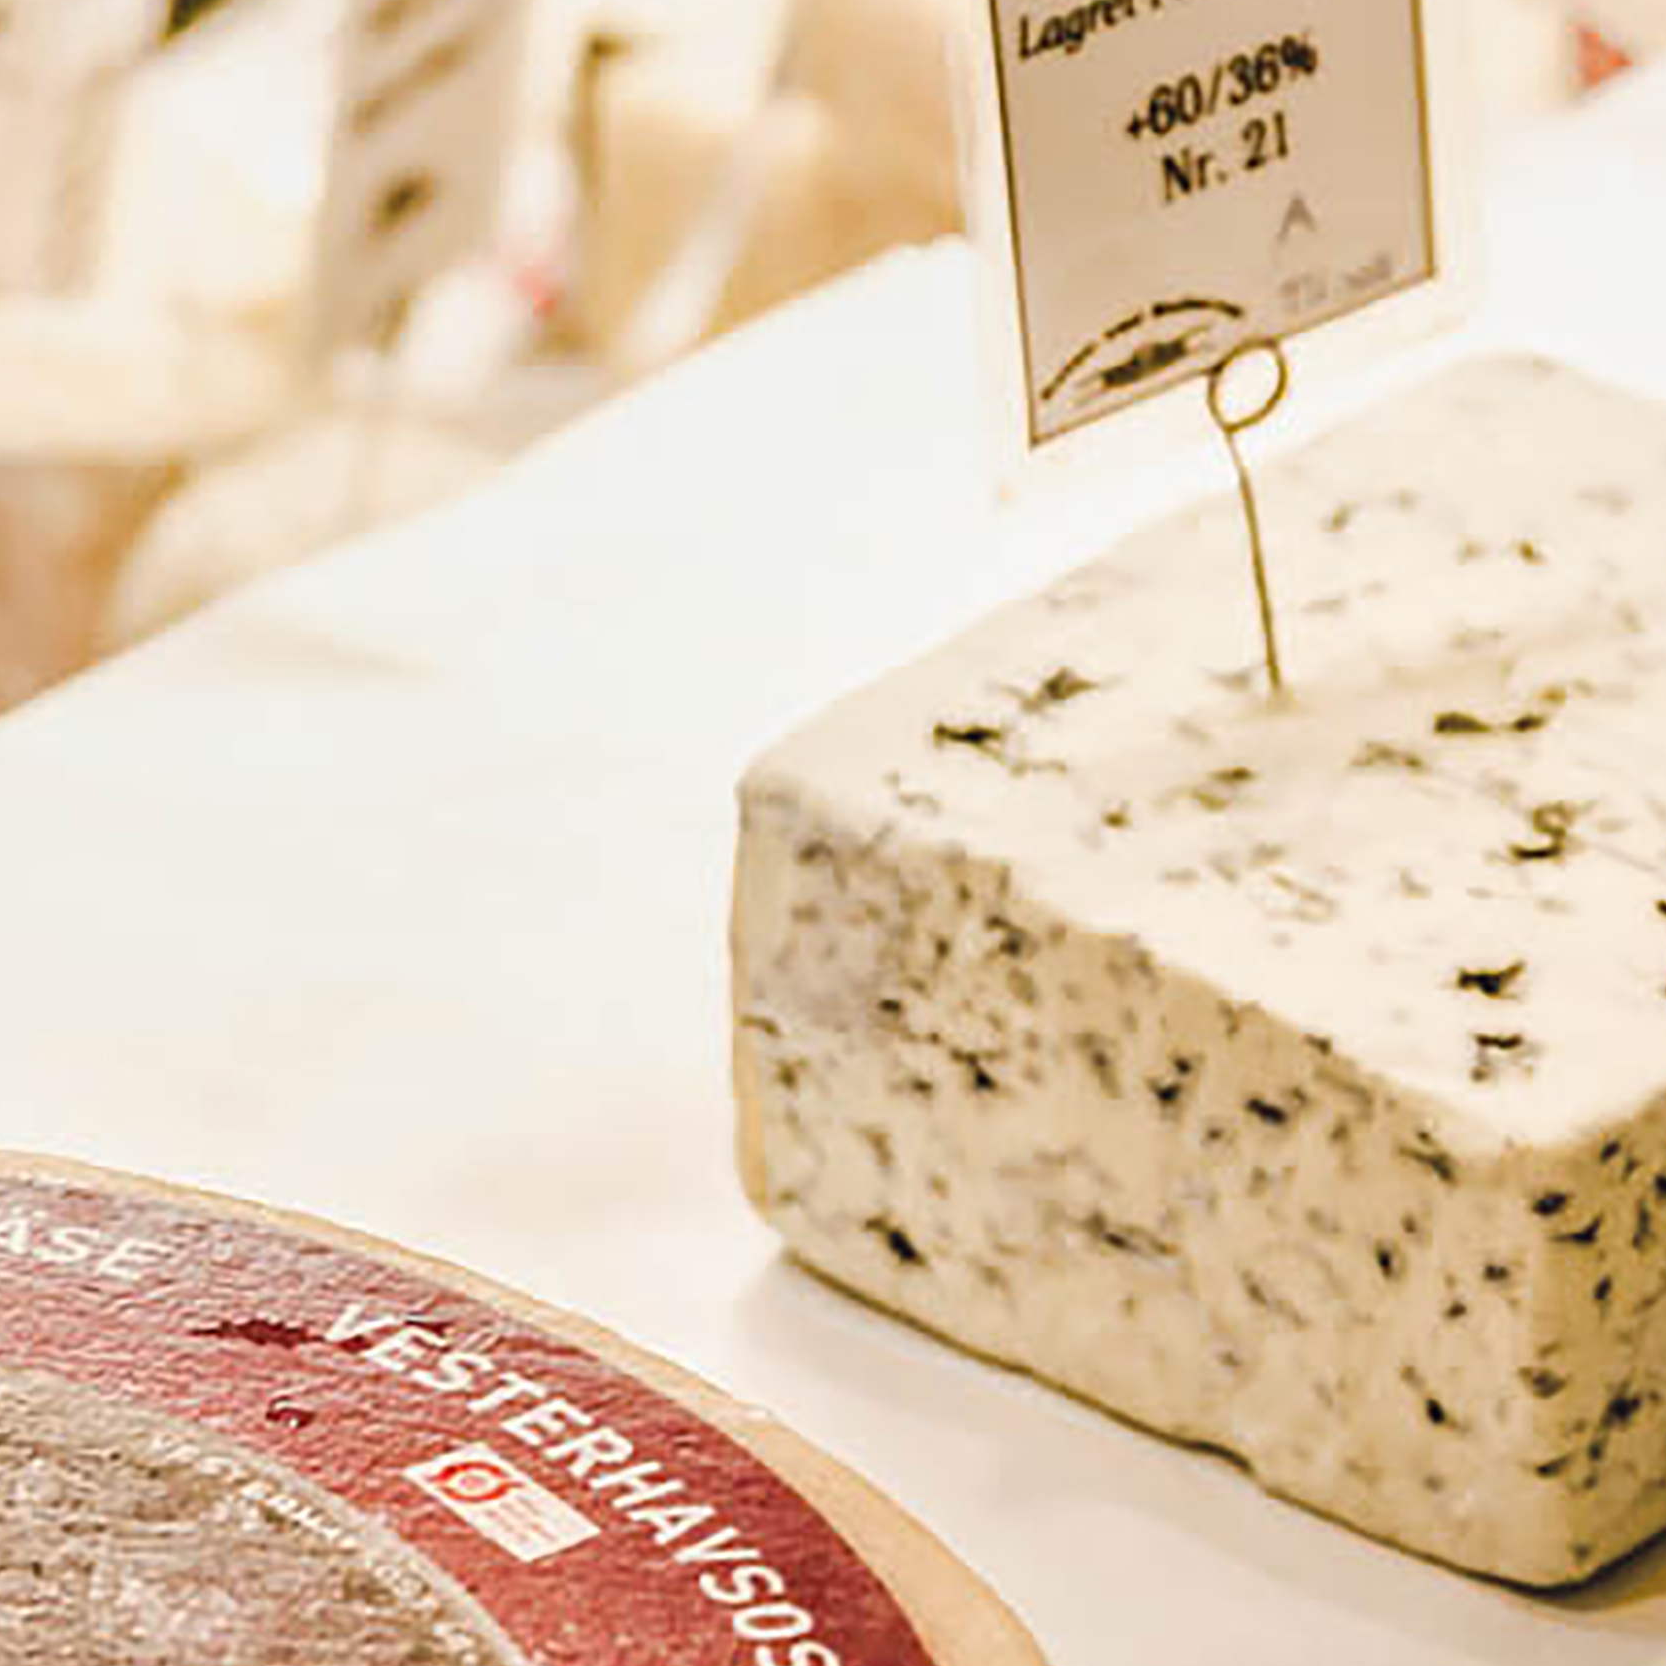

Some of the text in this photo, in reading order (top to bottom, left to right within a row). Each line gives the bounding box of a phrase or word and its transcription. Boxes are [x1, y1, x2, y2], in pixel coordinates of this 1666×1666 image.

[1126, 32, 1319, 139] +60/36%
[1160, 110, 1290, 203] Nr. 21
